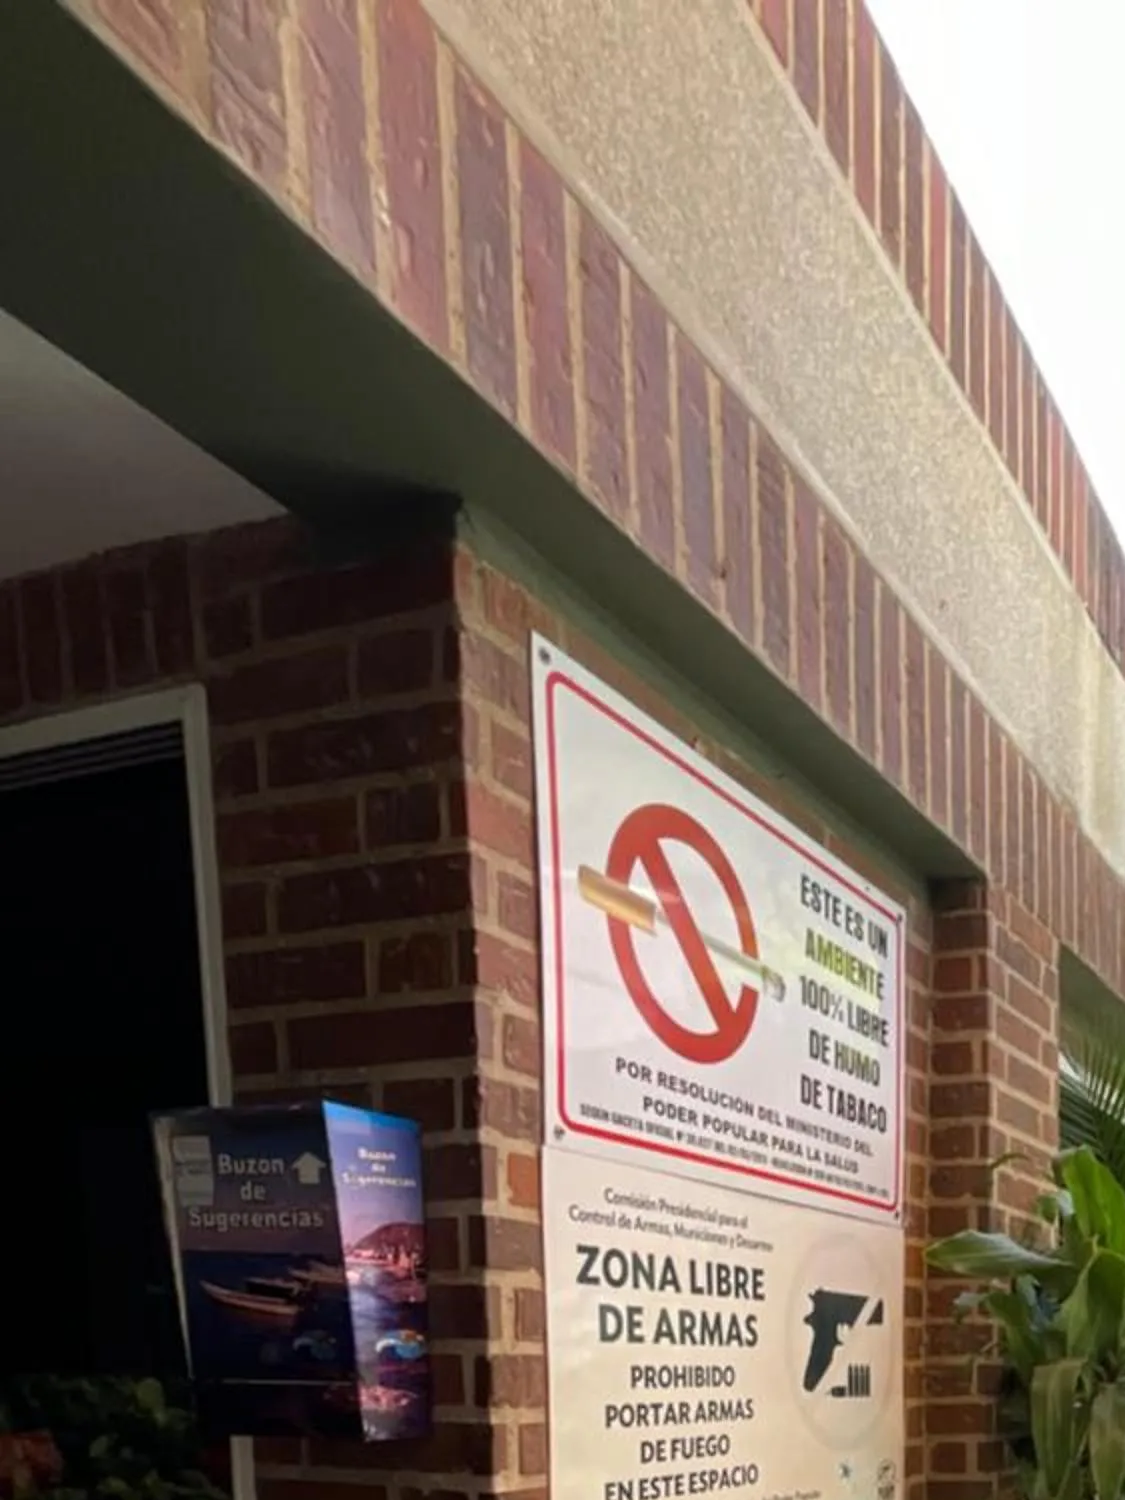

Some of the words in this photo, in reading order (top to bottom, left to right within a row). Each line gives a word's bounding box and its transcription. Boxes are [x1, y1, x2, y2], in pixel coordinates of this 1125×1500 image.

[801, 873, 841, 927] ESTE
[845, 904, 864, 943] ES
[868, 921, 889, 958] UN
[805, 928, 884, 1000] AMBIENTE
[799, 975, 844, 1022] 100%
[847, 1001, 889, 1048] LIBRE
[809, 1028, 831, 1065] DE
[834, 1040, 880, 1087] HUMO
[616, 1057, 652, 1083] POR
[758, 1106, 782, 1127] DEL
[786, 1115, 852, 1149] MINISTERIO
[854, 1139, 874, 1157] DEL
[800, 1074, 822, 1111] DE
[827, 1085, 888, 1134] TABACO
[643, 1096, 698, 1126] PODER
[702, 1114, 769, 1147] POPULAR
[772, 1135, 803, 1158] PARA
[806, 1146, 822, 1162] LA
[824, 1152, 859, 1174] SALUD
[217, 1153, 285, 1175] Buzon
[240, 1180, 266, 1201] de
[188, 1209, 324, 1232] Sugerencias
[568, 1203, 616, 1227] Control
[618, 1213, 632, 1229] de
[575, 1243, 681, 1294] ZONA
[690, 1258, 765, 1301] LIBRE
[599, 1303, 644, 1344] DE
[653, 1309, 759, 1348] ARMAS
[630, 1364, 735, 1389] PROHIBIDO
[605, 1403, 690, 1429] PORTAR
[694, 1399, 754, 1422] ARMAS
[640, 1440, 668, 1464] DE
[670, 1435, 731, 1461] FUEGO
[688, 1465, 759, 1498] ESPACIO
